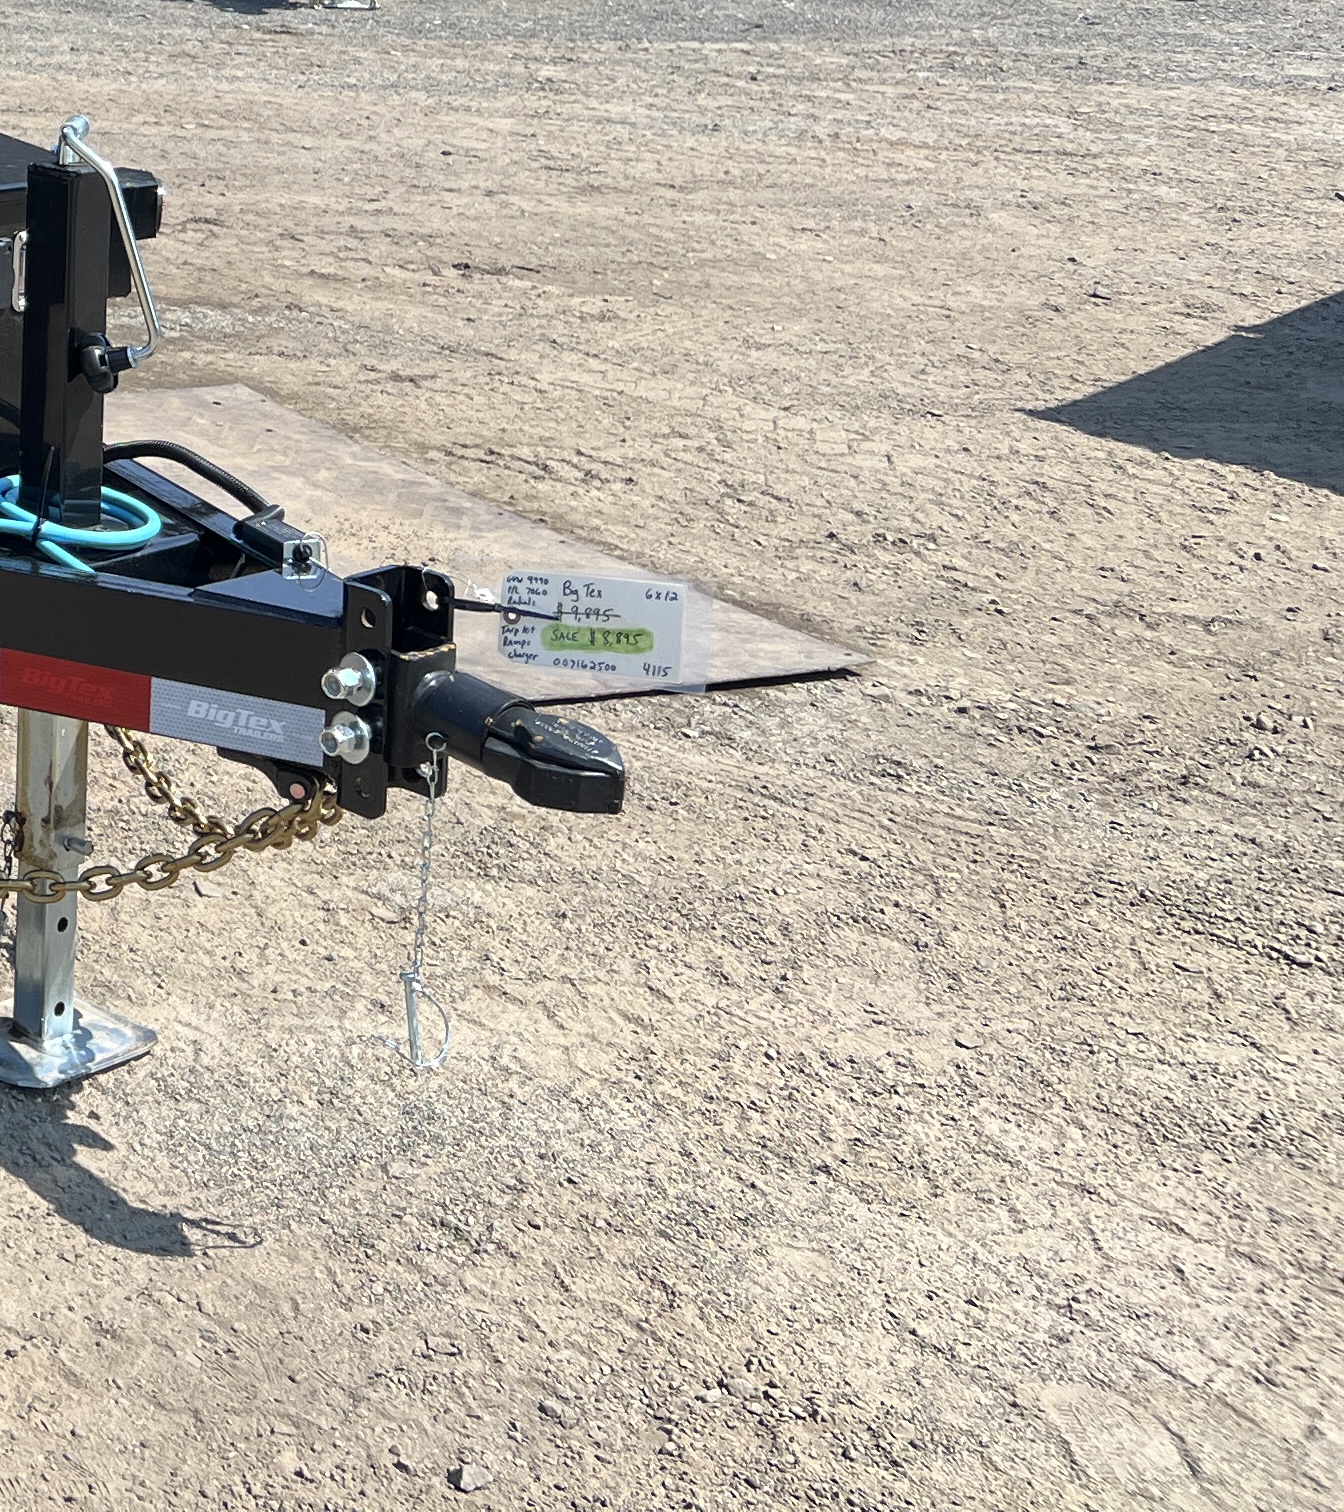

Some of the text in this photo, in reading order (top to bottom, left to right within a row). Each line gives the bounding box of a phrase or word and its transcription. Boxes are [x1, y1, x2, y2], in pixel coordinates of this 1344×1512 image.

[583, 582, 603, 599] Tex
[550, 628, 580, 642] SALE
[642, 662, 673, 678] 4115
[186, 699, 287, 735] BigTex
